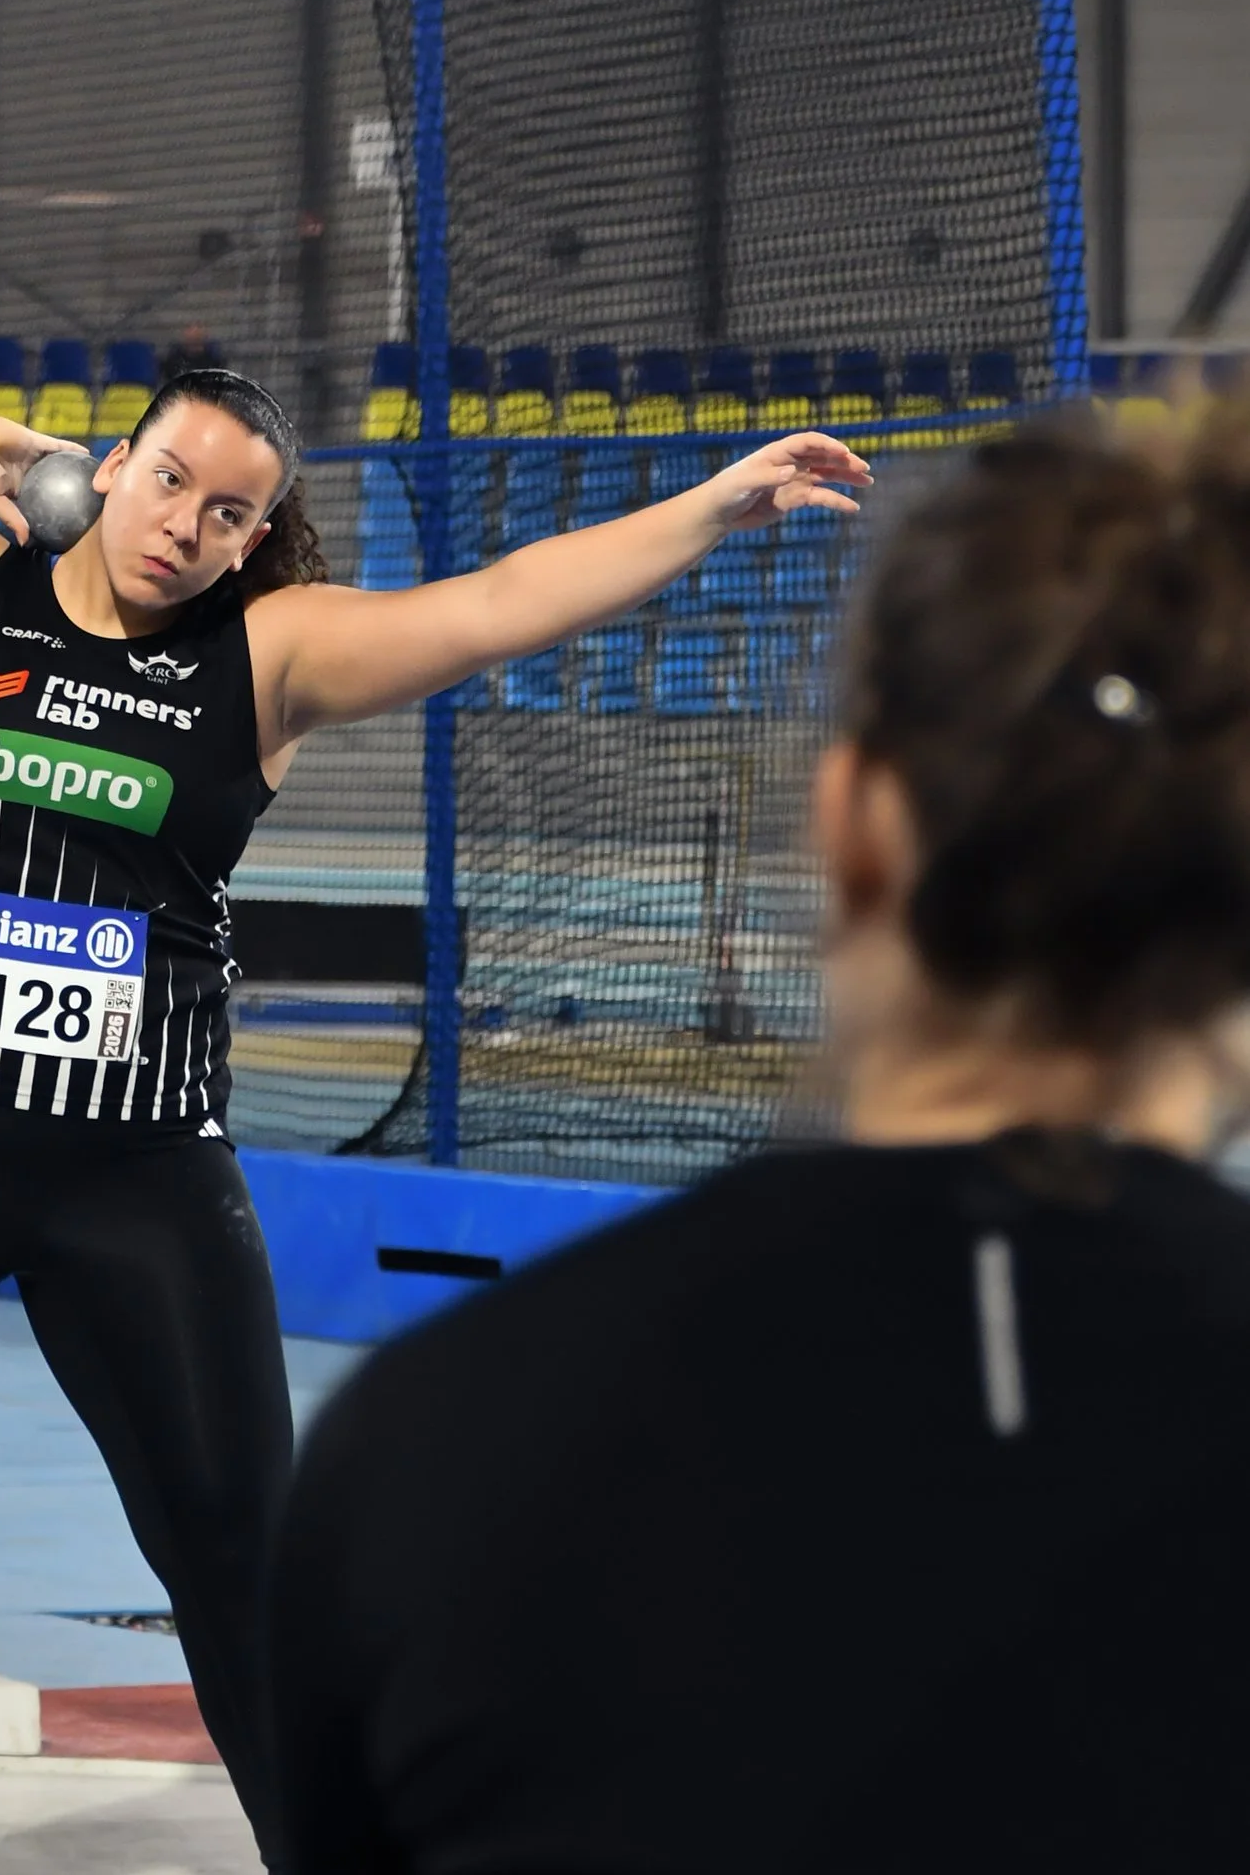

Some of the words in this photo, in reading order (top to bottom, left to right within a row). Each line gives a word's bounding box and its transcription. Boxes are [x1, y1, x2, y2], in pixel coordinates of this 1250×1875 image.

[1, 626, 53, 644] CRAFT
[144, 667, 177, 680] KRC
[36, 692, 100, 731] lab
[44, 674, 202, 731] runners'
[103, 1014, 125, 1057] 2026
